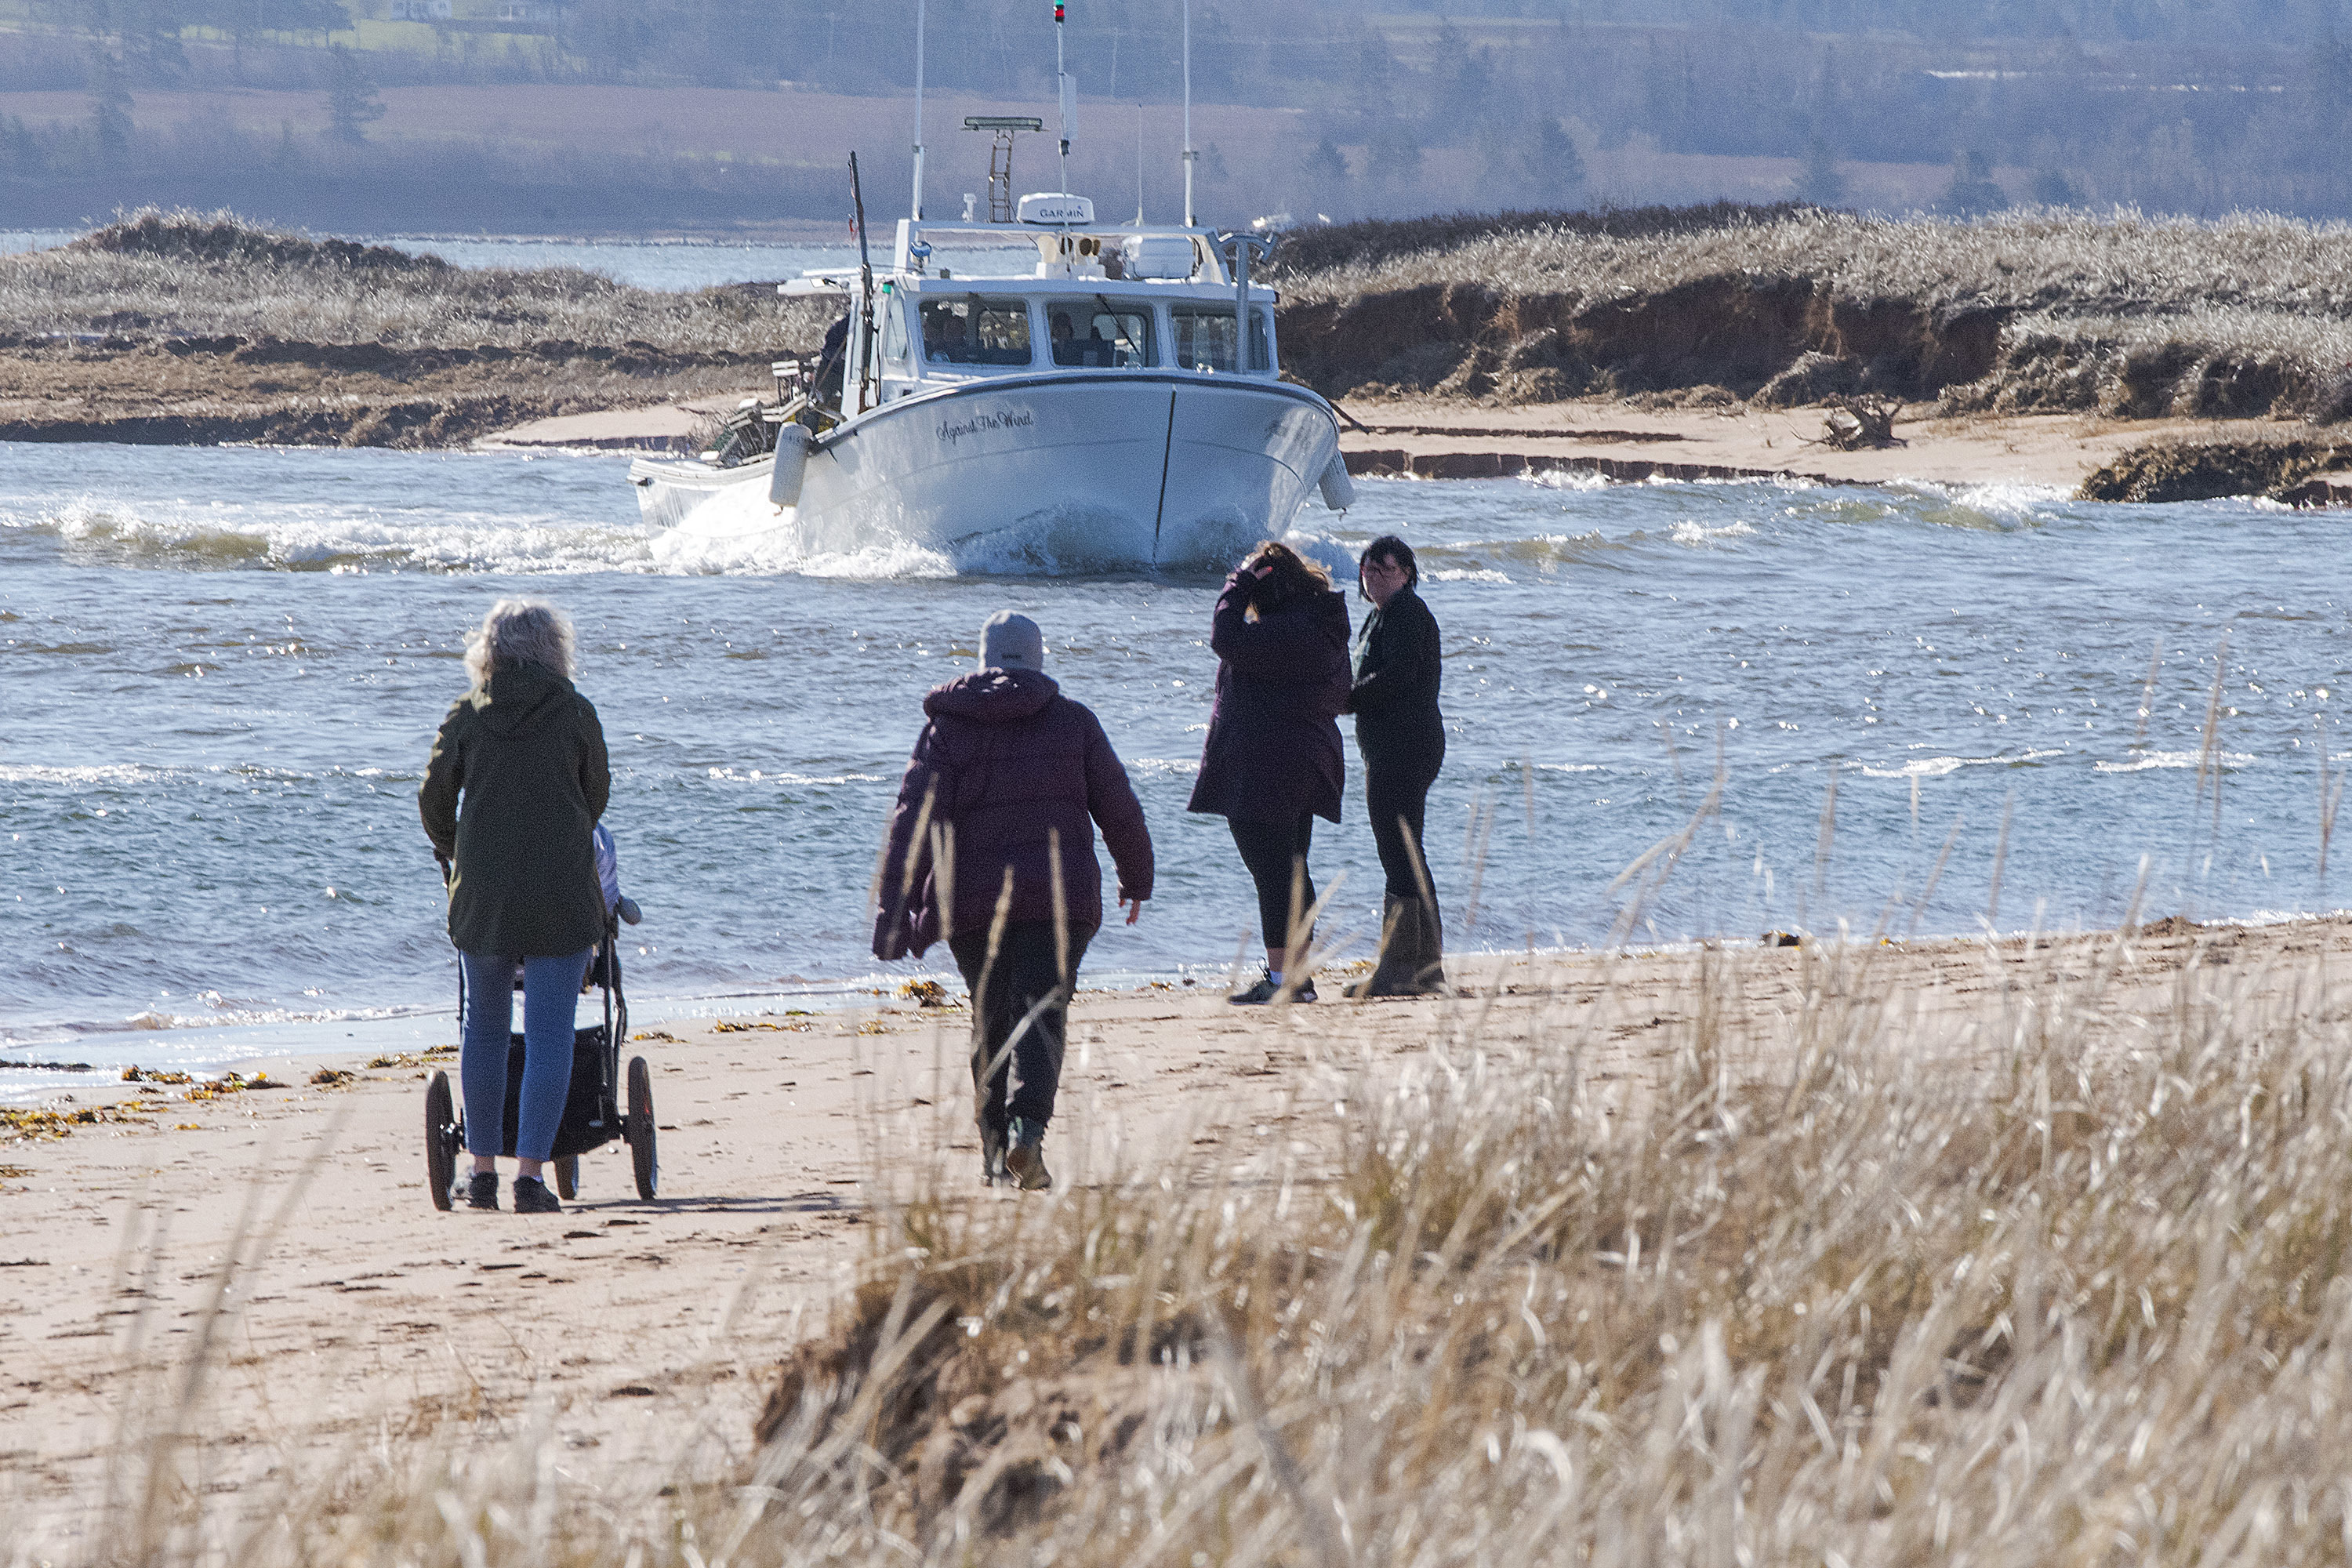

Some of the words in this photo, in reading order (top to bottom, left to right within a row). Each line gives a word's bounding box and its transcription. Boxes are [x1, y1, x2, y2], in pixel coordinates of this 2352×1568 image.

[1040, 209, 1084, 218] GARMIN
[936, 419, 978, 445] Against
[977, 416, 1000, 431] The
[997, 410, 1034, 428] Wind
